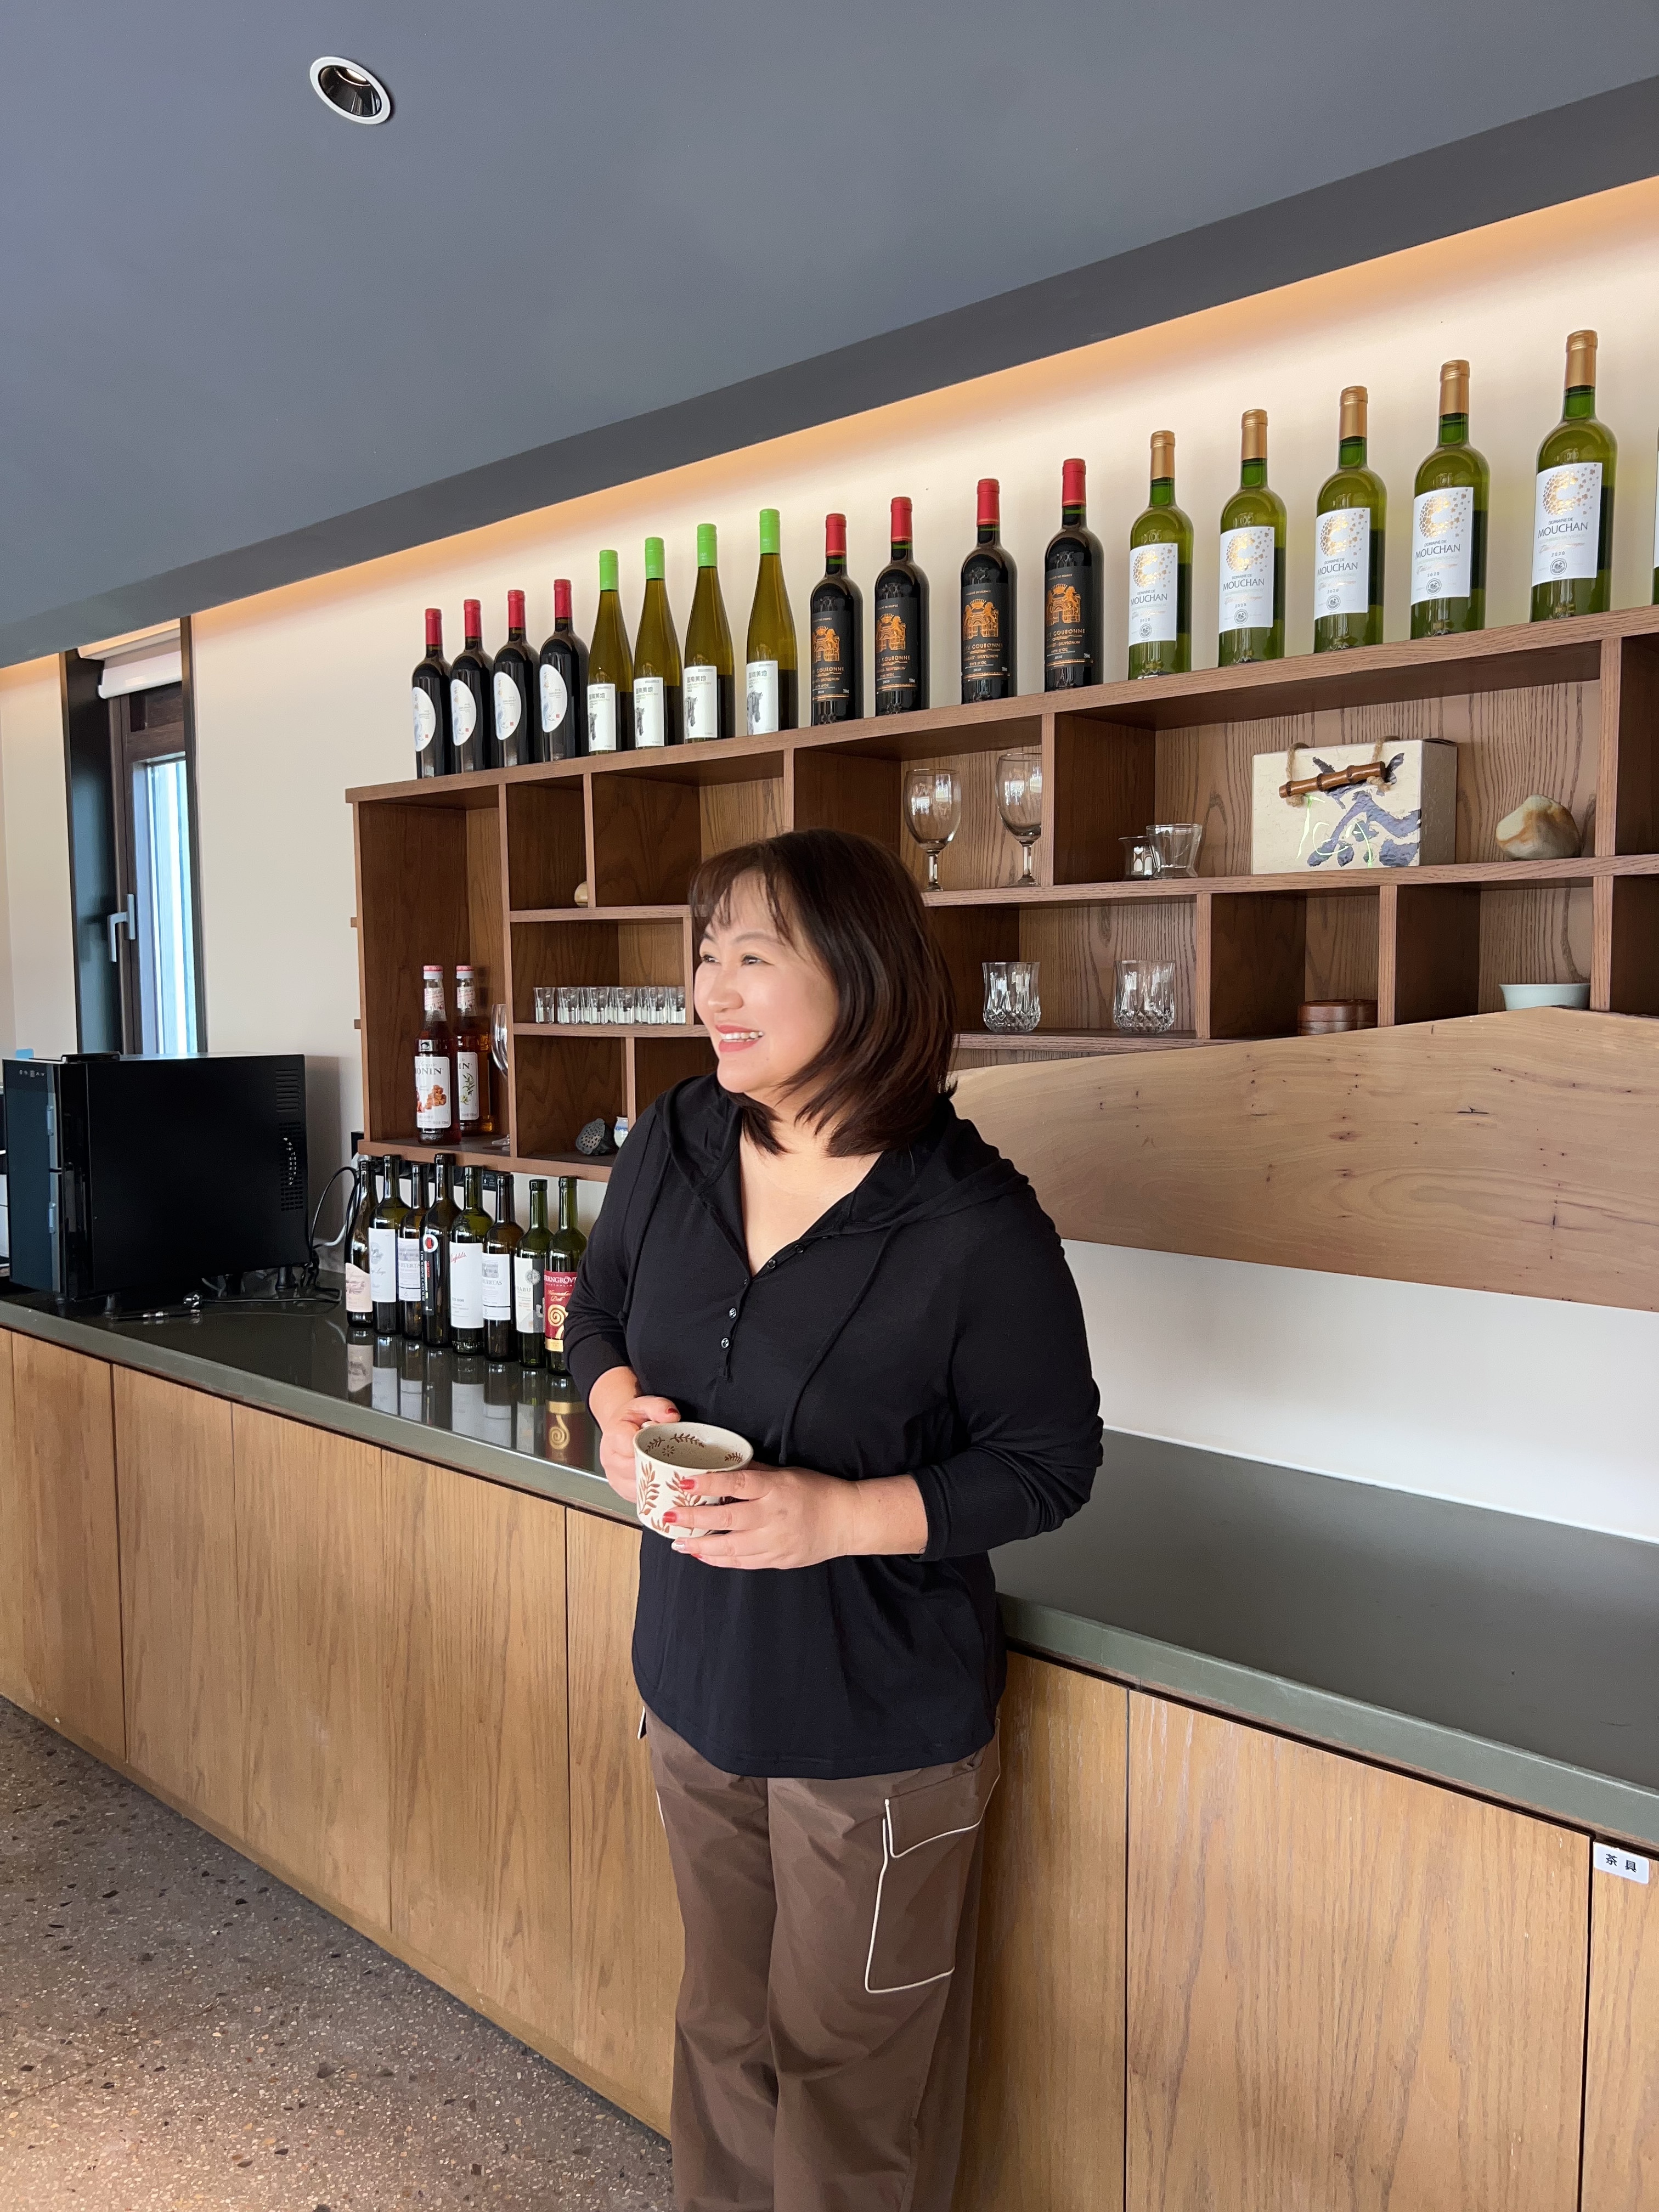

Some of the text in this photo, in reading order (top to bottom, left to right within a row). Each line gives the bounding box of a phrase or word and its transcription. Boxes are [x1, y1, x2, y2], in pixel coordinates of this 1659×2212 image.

[1538, 522, 1588, 539] MOUCHAN
[1415, 544, 1461, 559] MOUCHAN
[1317, 562, 1358, 576] MOUCHAN
[1223, 578, 1265, 591] MOUCHAN
[1131, 593, 1167, 606] MOUCHAN
[544, 1274, 577, 1284] ERNGROV
[1605, 1853, 1637, 1873] 茶具
